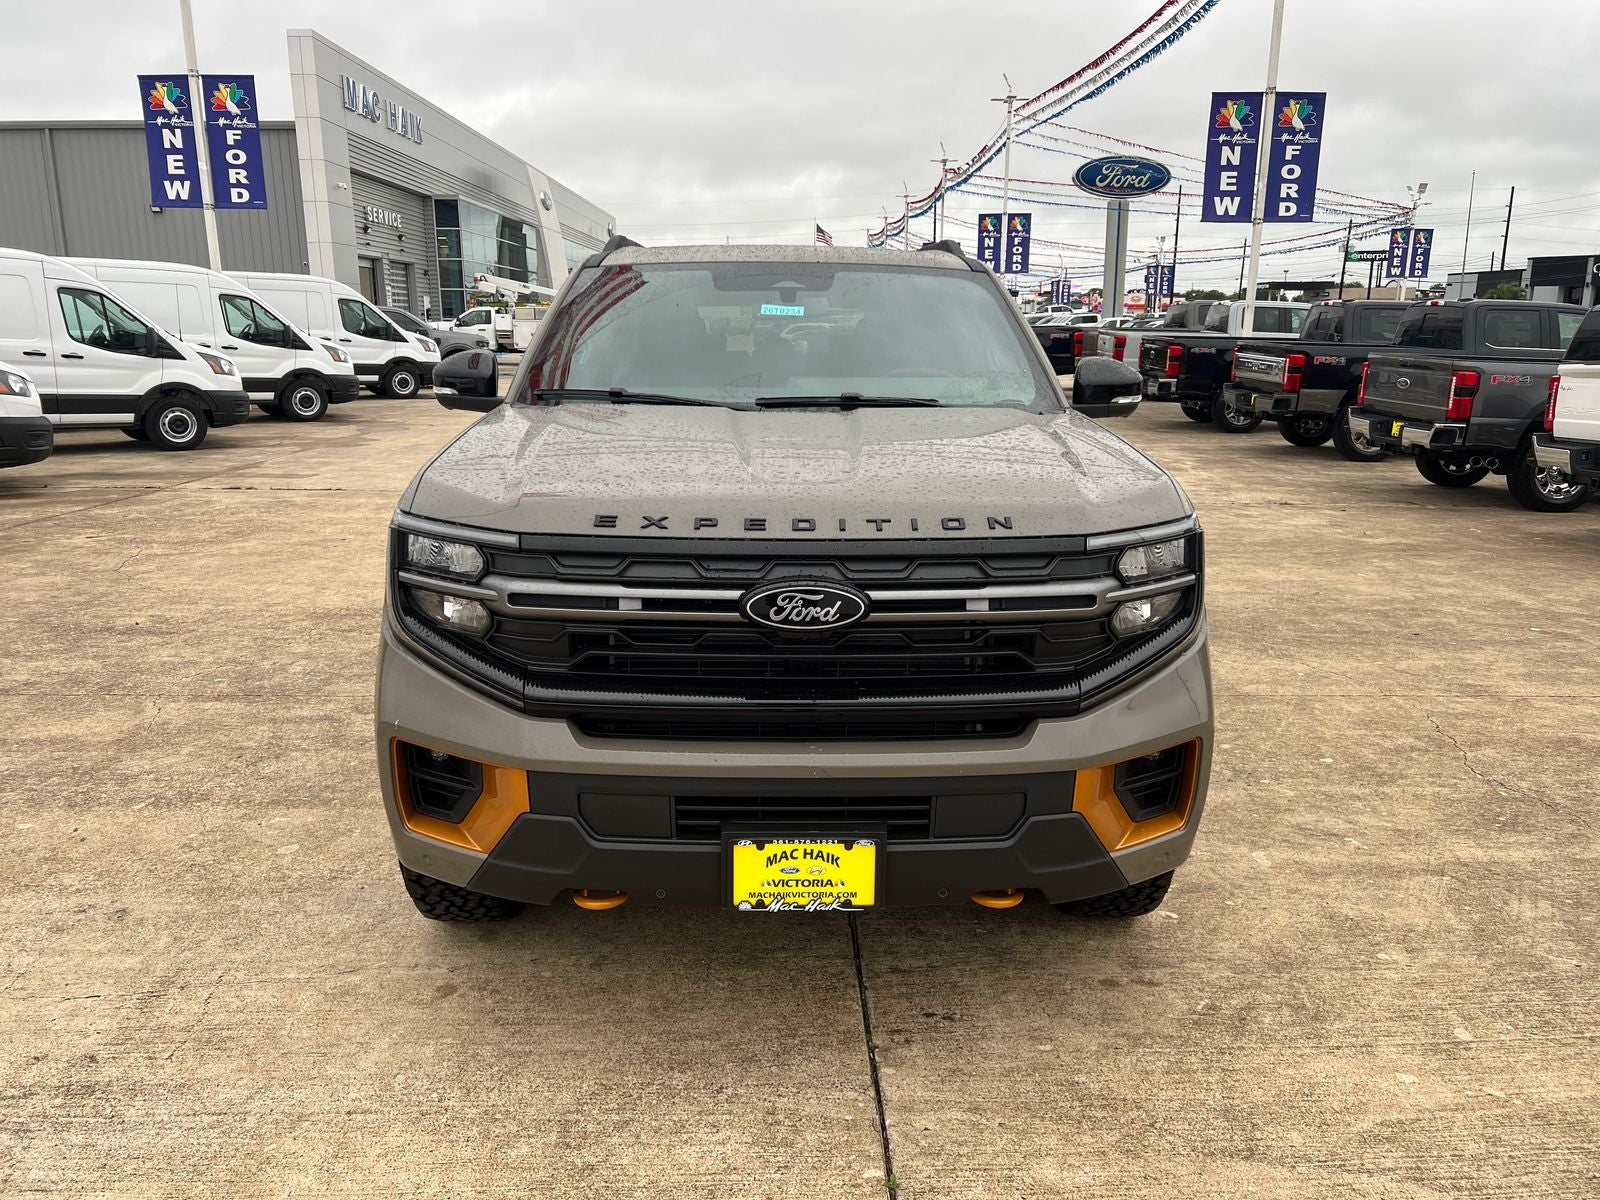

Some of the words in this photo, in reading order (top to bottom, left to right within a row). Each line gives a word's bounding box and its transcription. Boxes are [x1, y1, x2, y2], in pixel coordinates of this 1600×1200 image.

[342, 74, 381, 123] MAC
[385, 99, 423, 145] HAIK
[161, 128, 191, 200] NEW
[225, 129, 250, 203] FORD
[1095, 163, 1152, 189] Ford
[1213, 145, 1241, 216] NEW
[1278, 145, 1302, 217] FORD
[366, 205, 402, 228] SERVICE
[1012, 237, 1023, 271] FORD
[1351, 250, 1388, 261] enterpri
[1390, 248, 1402, 276] NEW
[1414, 248, 1424, 276] FORD
[1491, 374, 1534, 386] FX4
[593, 513, 1013, 532] EXPEDITION
[769, 592, 842, 623] Ford
[766, 848, 799, 868] MAC
[803, 848, 841, 868] HAIK
[748, 891, 858, 899] MACHAIKVICTORIA.COM
[771, 879, 834, 888] VICTORIA
[766, 894, 799, 912] Mac
[804, 895, 844, 912] Haik
